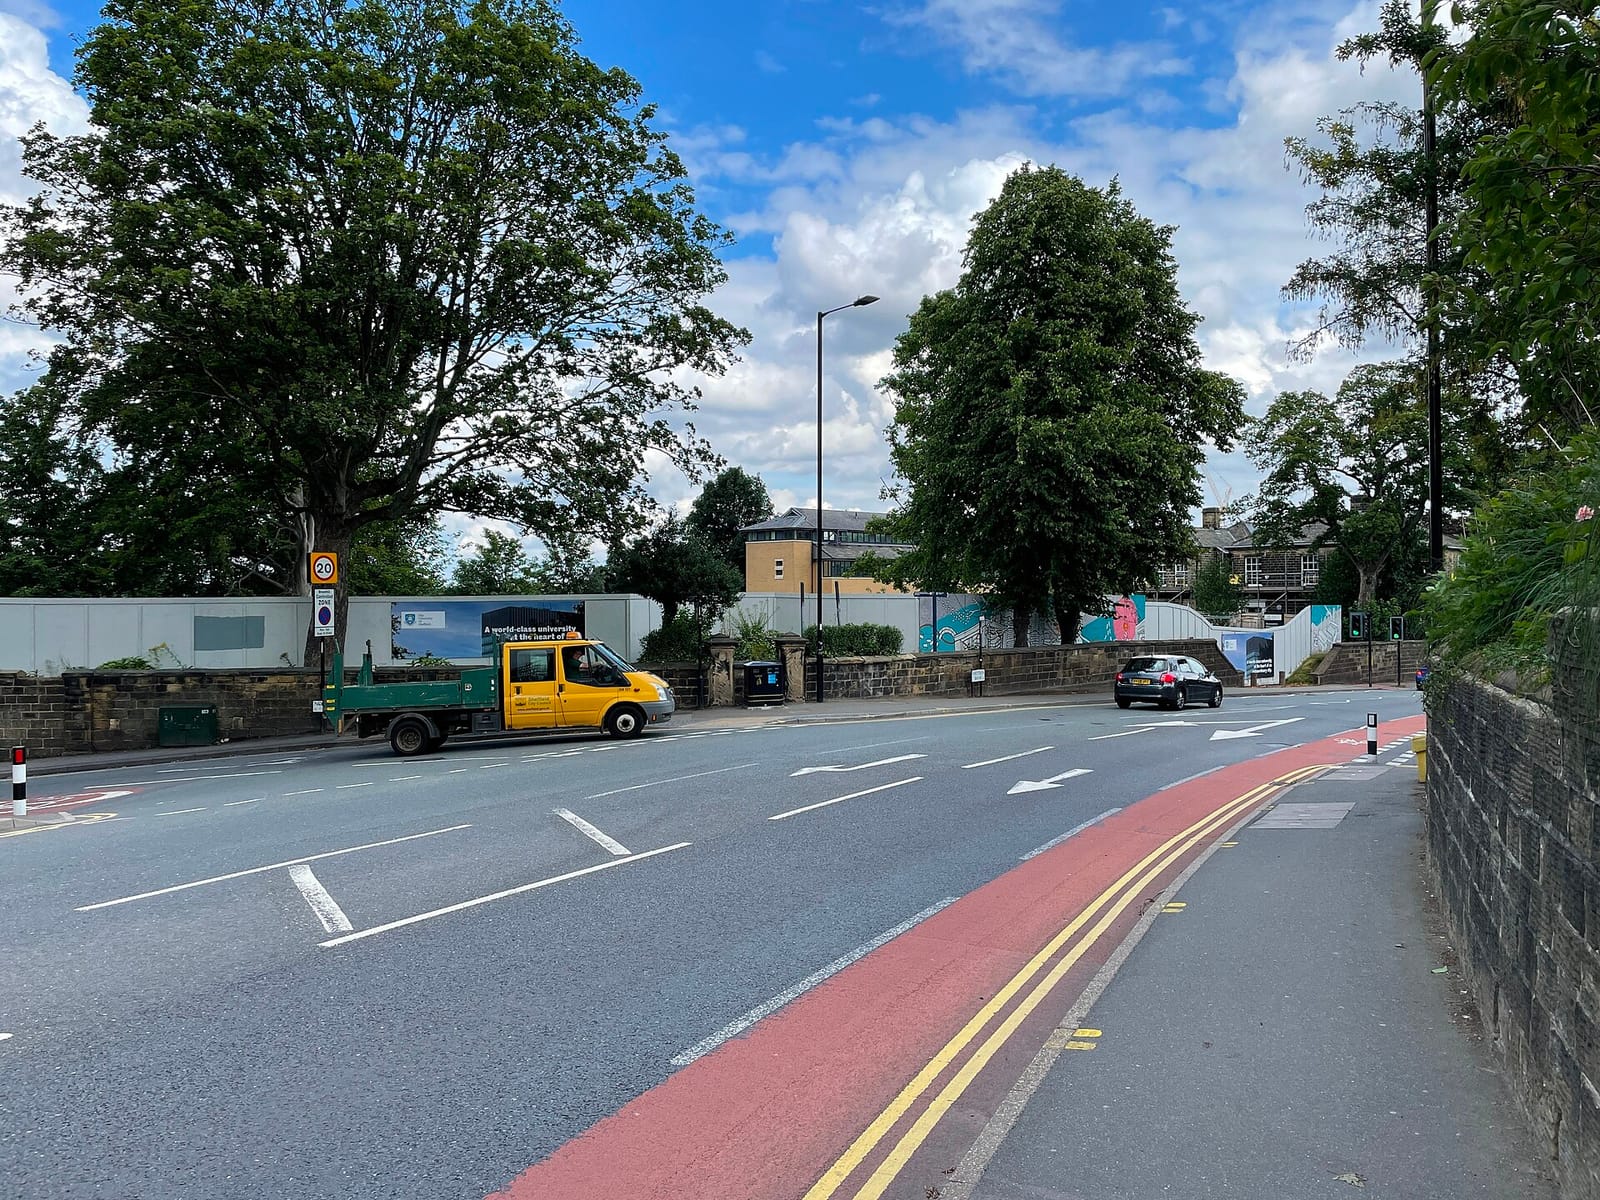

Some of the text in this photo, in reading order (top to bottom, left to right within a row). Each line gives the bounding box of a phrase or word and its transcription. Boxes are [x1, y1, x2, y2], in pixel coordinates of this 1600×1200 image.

[317, 563, 332, 573] 20
[491, 625, 537, 633] world-class
[537, 625, 576, 633] university
